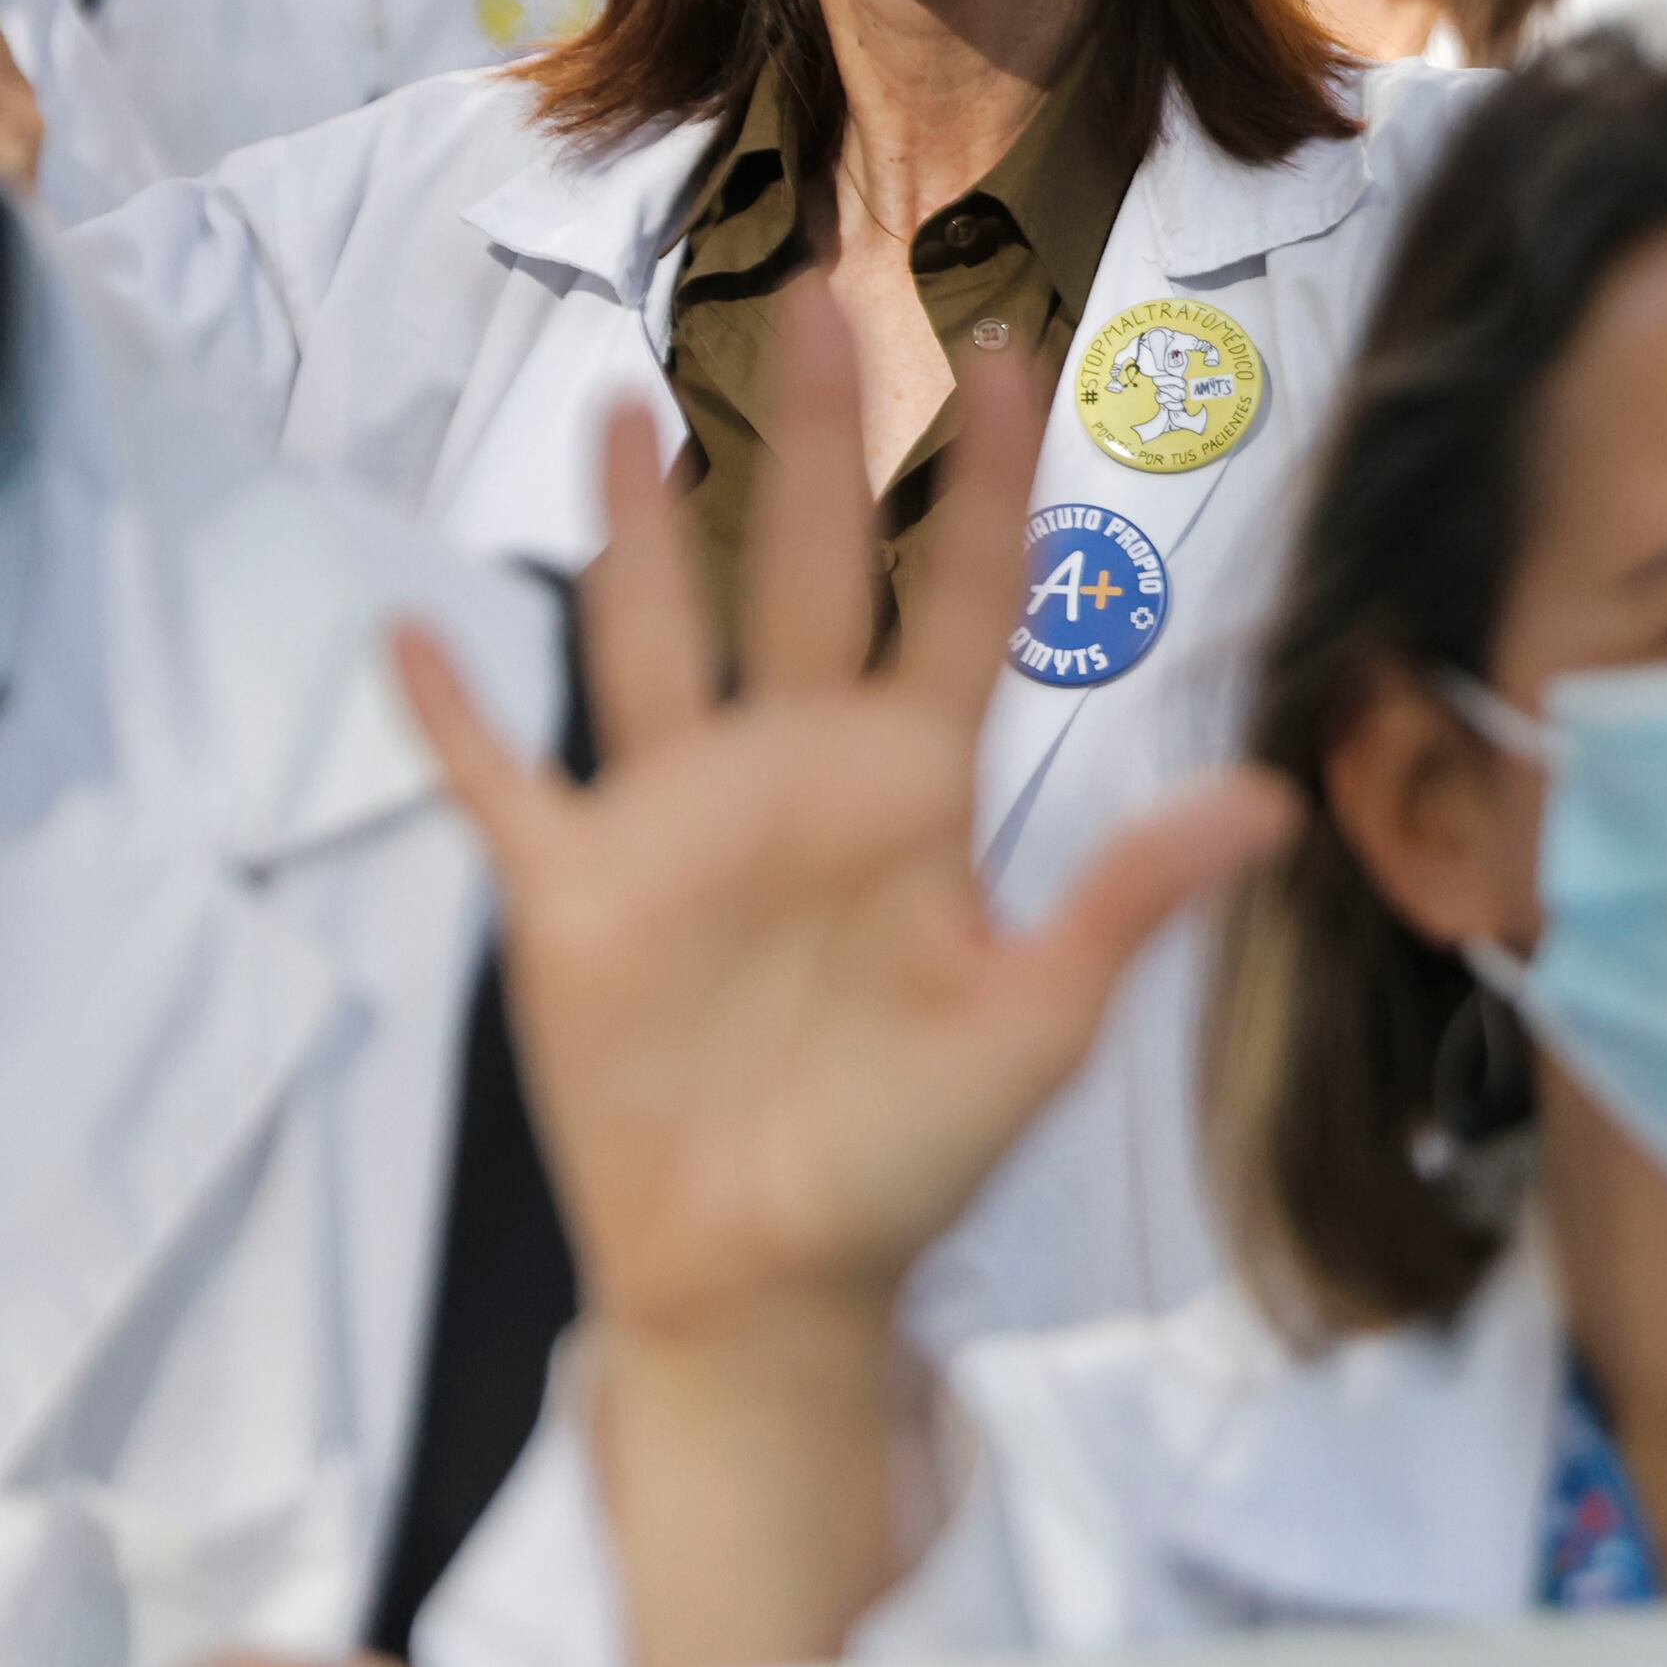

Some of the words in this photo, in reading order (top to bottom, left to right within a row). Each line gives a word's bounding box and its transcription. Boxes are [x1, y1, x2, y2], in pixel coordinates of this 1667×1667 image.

[1138, 451, 1165, 466] POR
[1171, 449, 1197, 466] TUS
[1201, 395, 1252, 456] PACIENTES
[1104, 516, 1162, 594] PROPIO
[1009, 626, 1109, 676] AMYTS
